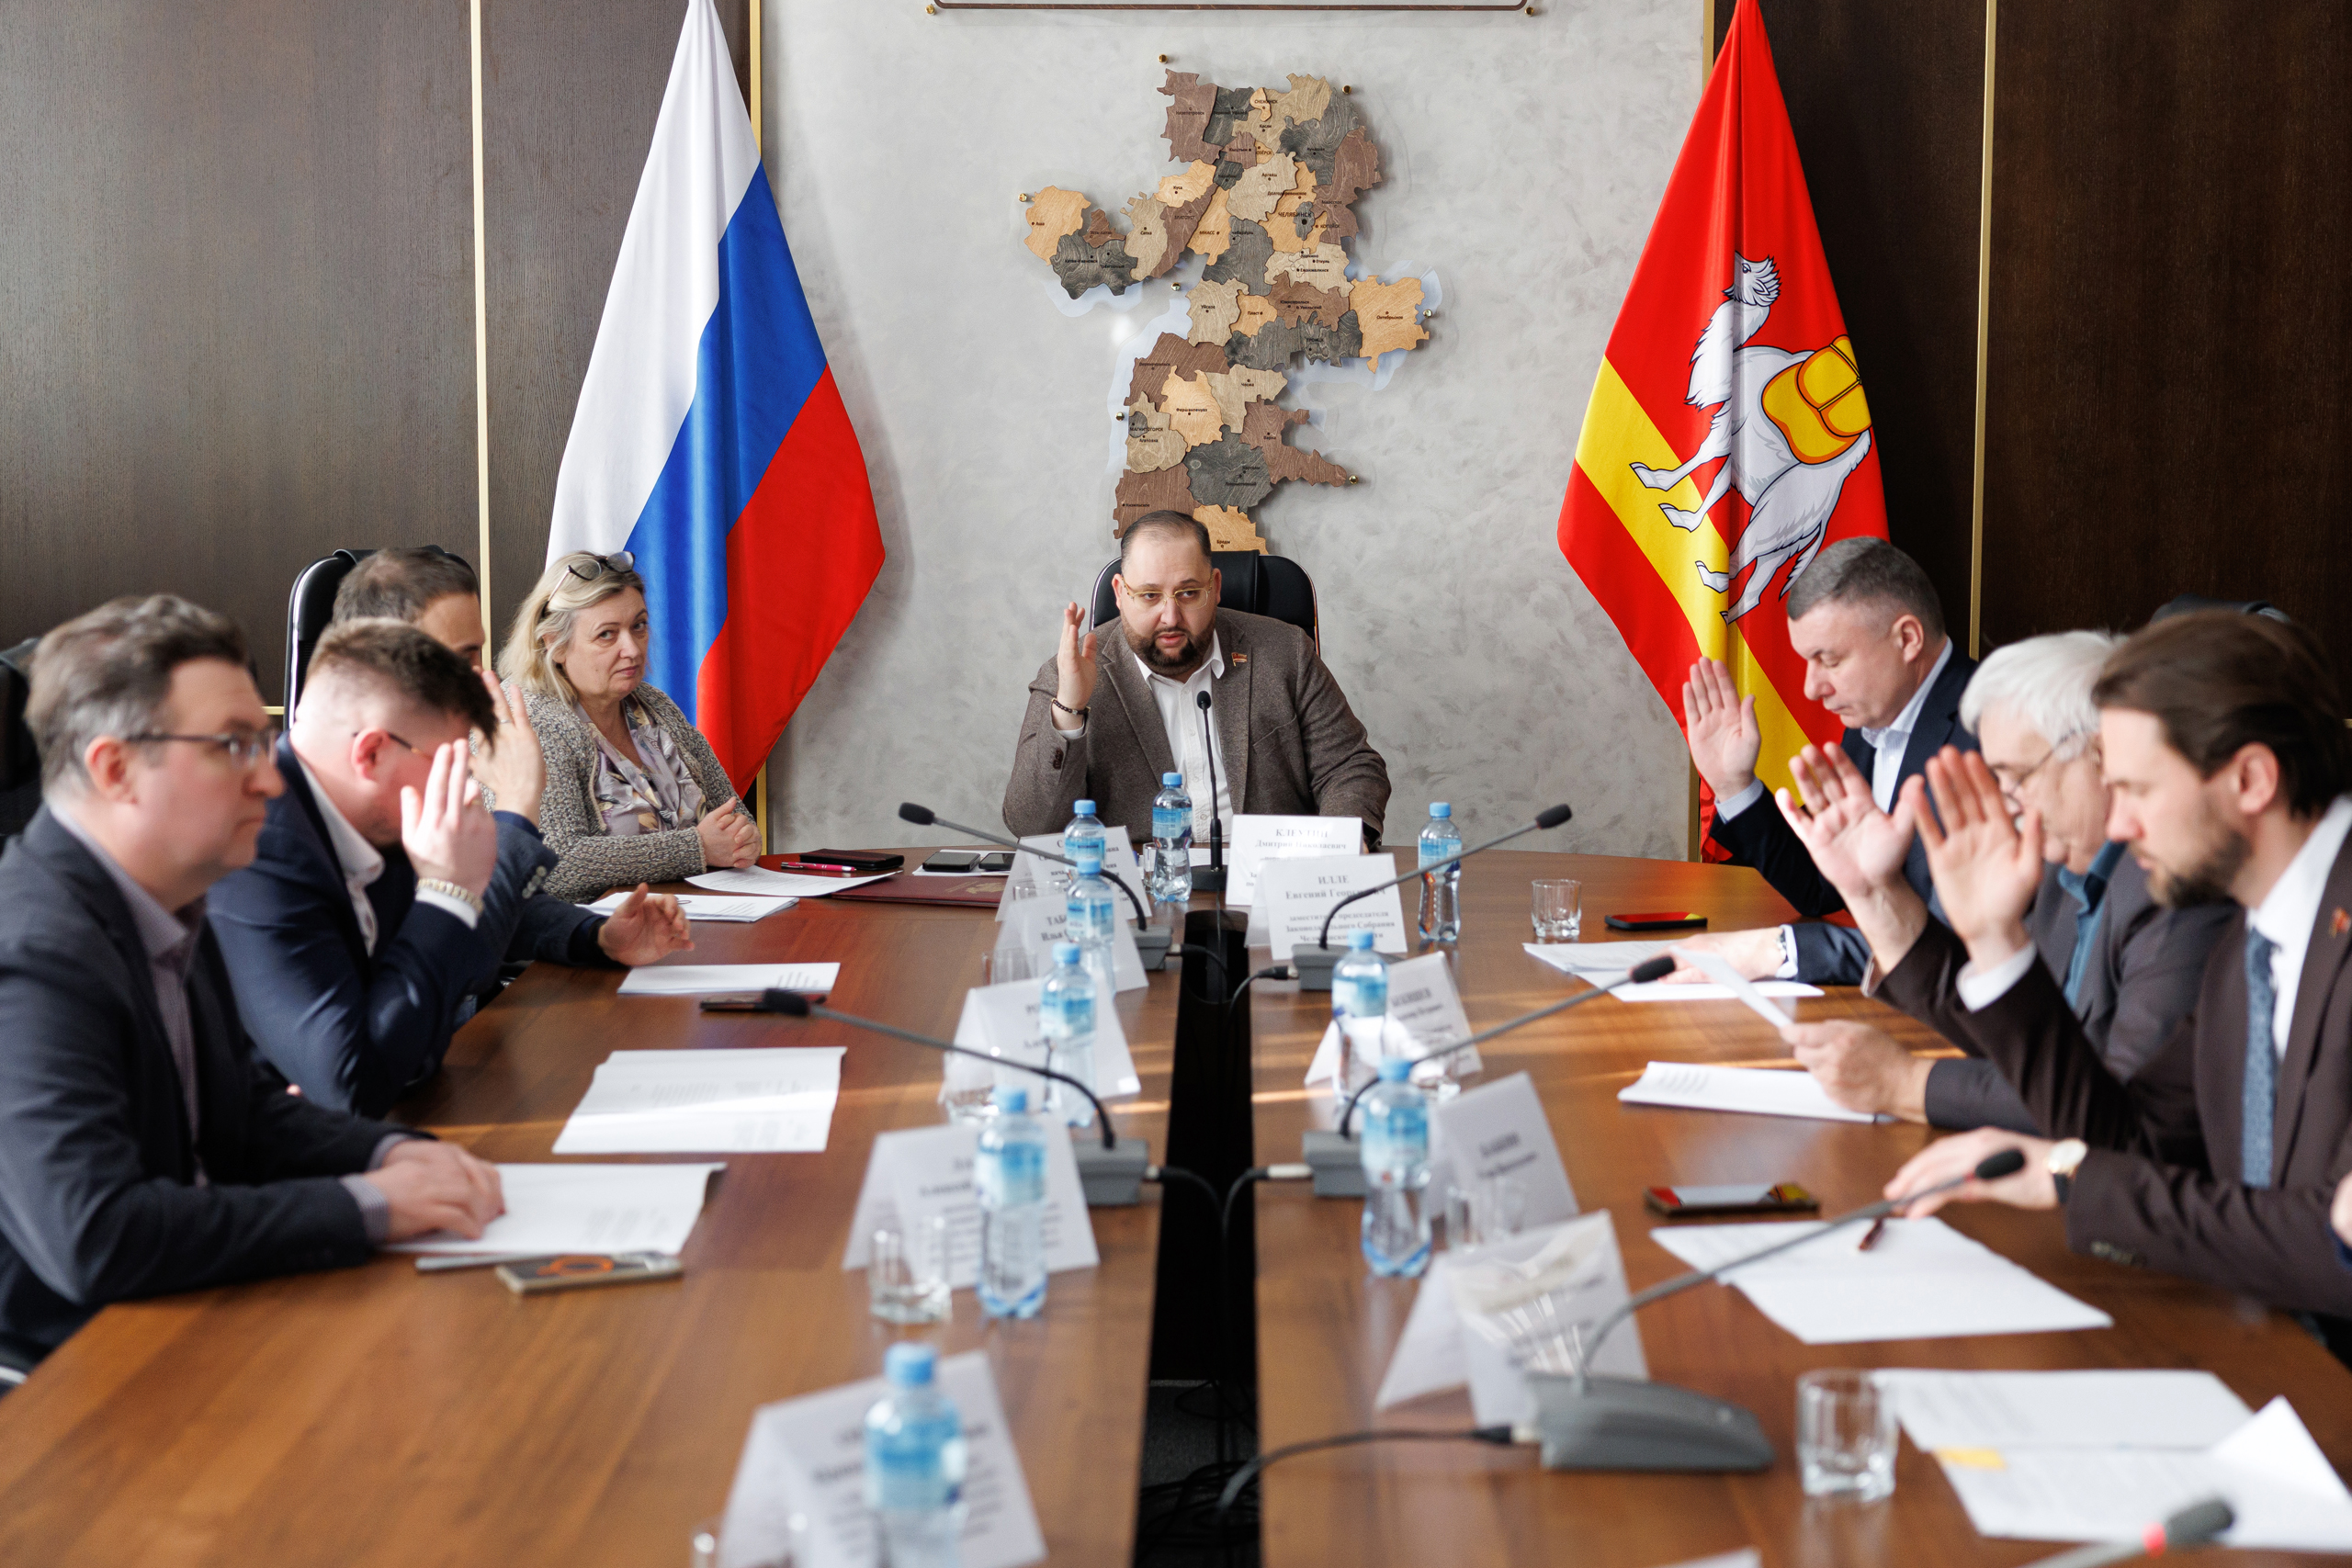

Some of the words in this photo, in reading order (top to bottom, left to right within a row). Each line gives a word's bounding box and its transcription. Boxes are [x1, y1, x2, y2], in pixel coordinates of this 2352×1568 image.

[1255, 840, 1293, 849] Дмитрий
[1318, 874, 1350, 885] ИЛЛЕ
[1285, 890, 1327, 899] Евгений
[1357, 920, 1396, 930] Собрания
